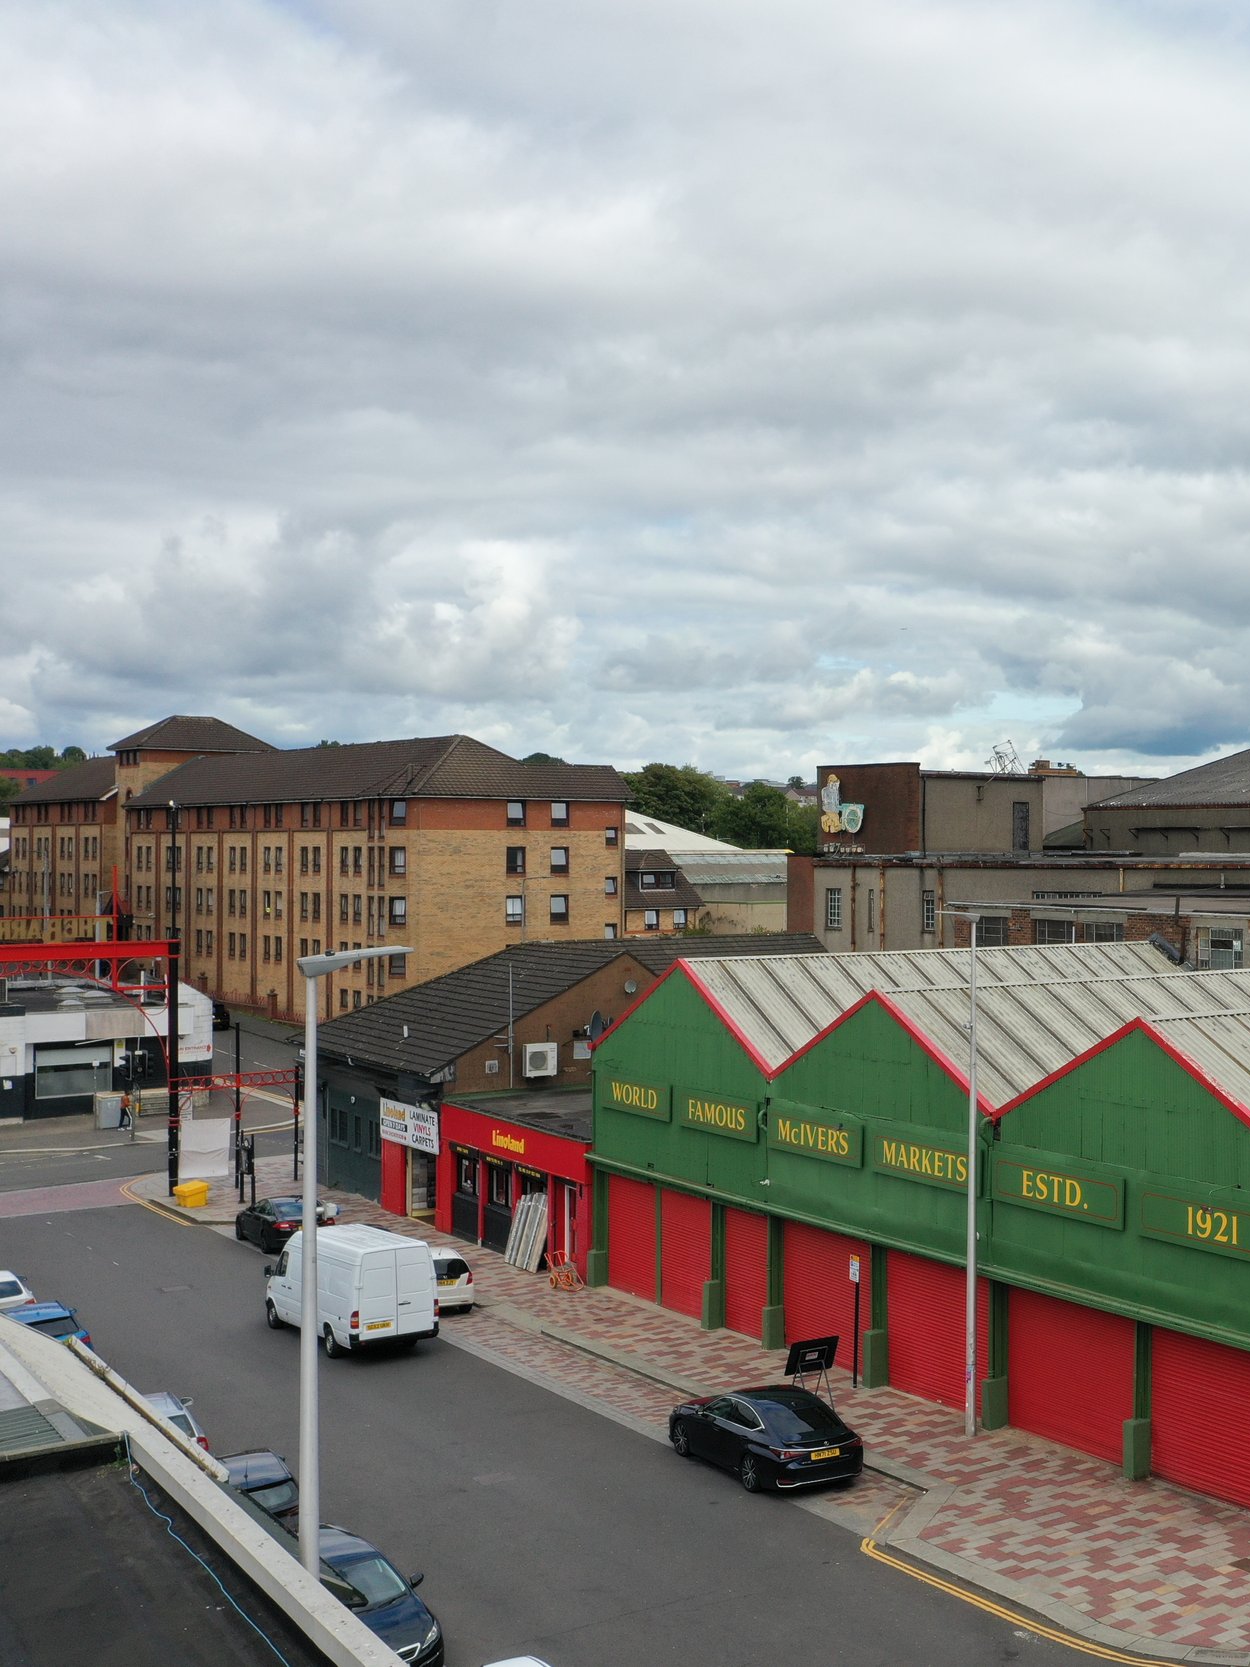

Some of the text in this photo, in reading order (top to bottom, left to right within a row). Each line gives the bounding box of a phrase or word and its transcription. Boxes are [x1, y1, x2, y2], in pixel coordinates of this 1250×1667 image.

[410, 1110, 435, 1126] LAMINATE
[414, 1122, 431, 1136] VINYLS
[411, 1133, 435, 1149] CARPETS
[491, 1129, 525, 1154] Linoland
[611, 1081, 1238, 1245] WORLD FAMOUS McIVER'S MARKETS ESTD. 1921
